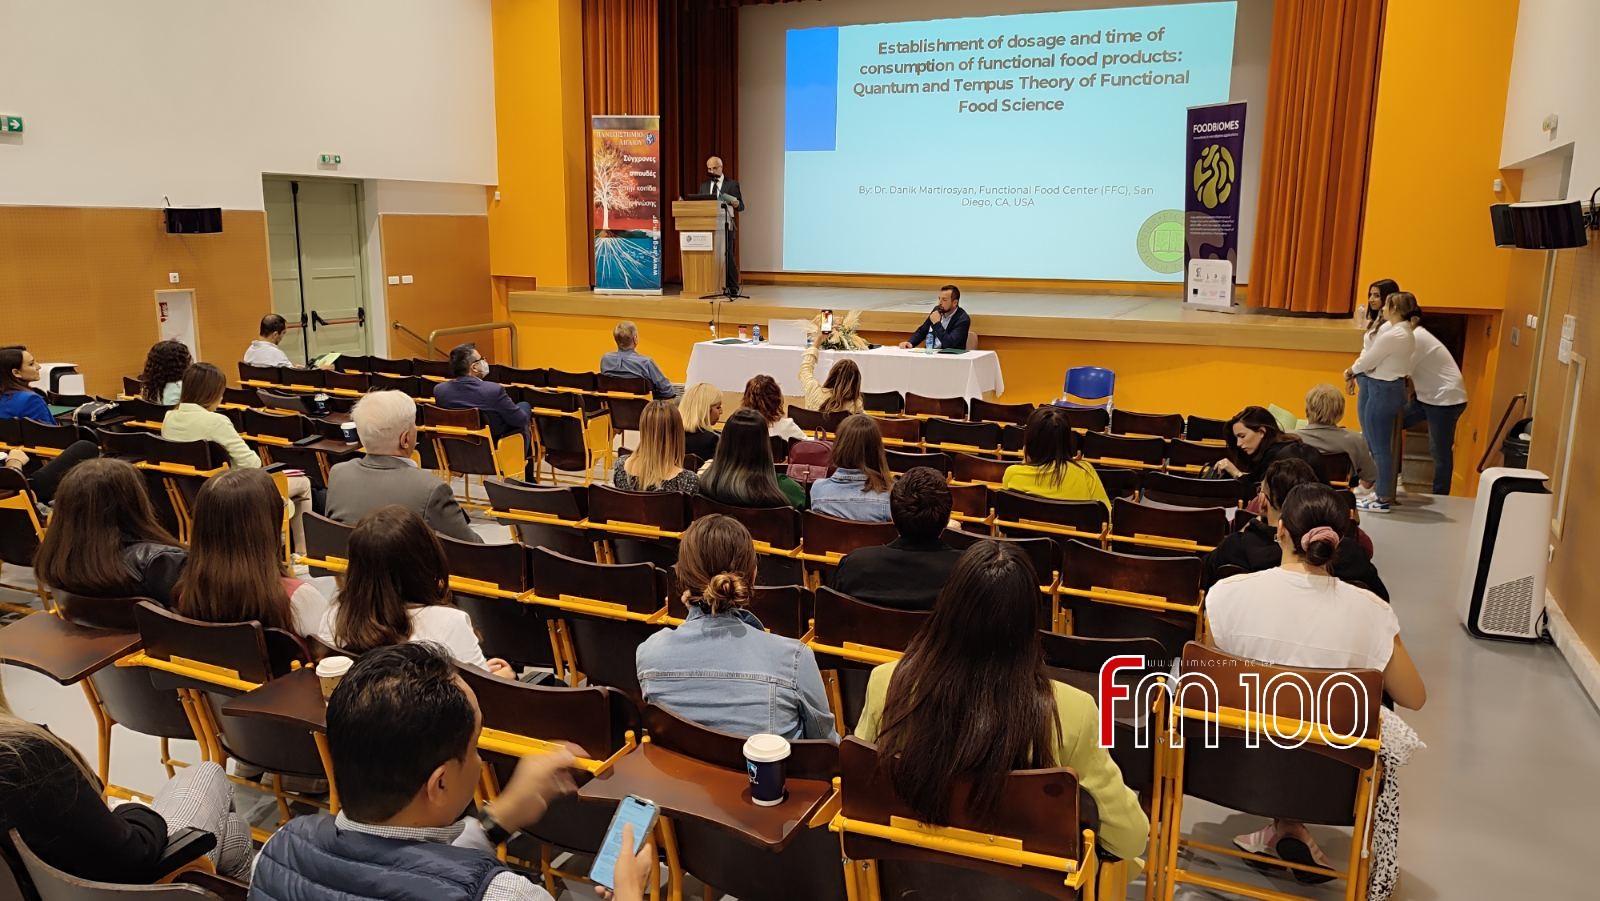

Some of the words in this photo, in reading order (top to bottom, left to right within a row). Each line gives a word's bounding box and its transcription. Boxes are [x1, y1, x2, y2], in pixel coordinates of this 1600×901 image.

[878, 37, 984, 55] Establishment
[987, 35, 1005, 49] of
[1007, 34, 1066, 50] dosage
[1070, 30, 1102, 46] and
[1105, 29, 1142, 43] time
[1147, 26, 1165, 42] of
[859, 58, 954, 76] consumption
[958, 56, 975, 71] of
[978, 54, 1056, 71] functional
[1060, 51, 1098, 67] food
[1102, 50, 1183, 69] products:
[853, 82, 919, 97] Quantum
[922, 79, 950, 93] and
[954, 78, 1014, 94] Tempus
[1019, 75, 1075, 91] Theory
[1079, 73, 1097, 88] of
[1101, 70, 1190, 87] Functional
[959, 98, 998, 113] Food
[1001, 97, 1065, 112] Science
[1193, 120, 1239, 133] FOODBIOMES
[889, 185, 917, 195] Danik
[919, 185, 977, 196] Martirosyan,
[979, 185, 1032, 195] Functional
[1034, 185, 1060, 195] Food
[1062, 185, 1098, 195] Center
[1133, 185, 1154, 195] San
[961, 197, 993, 208] Diego,
[1014, 197, 1035, 207] USA
